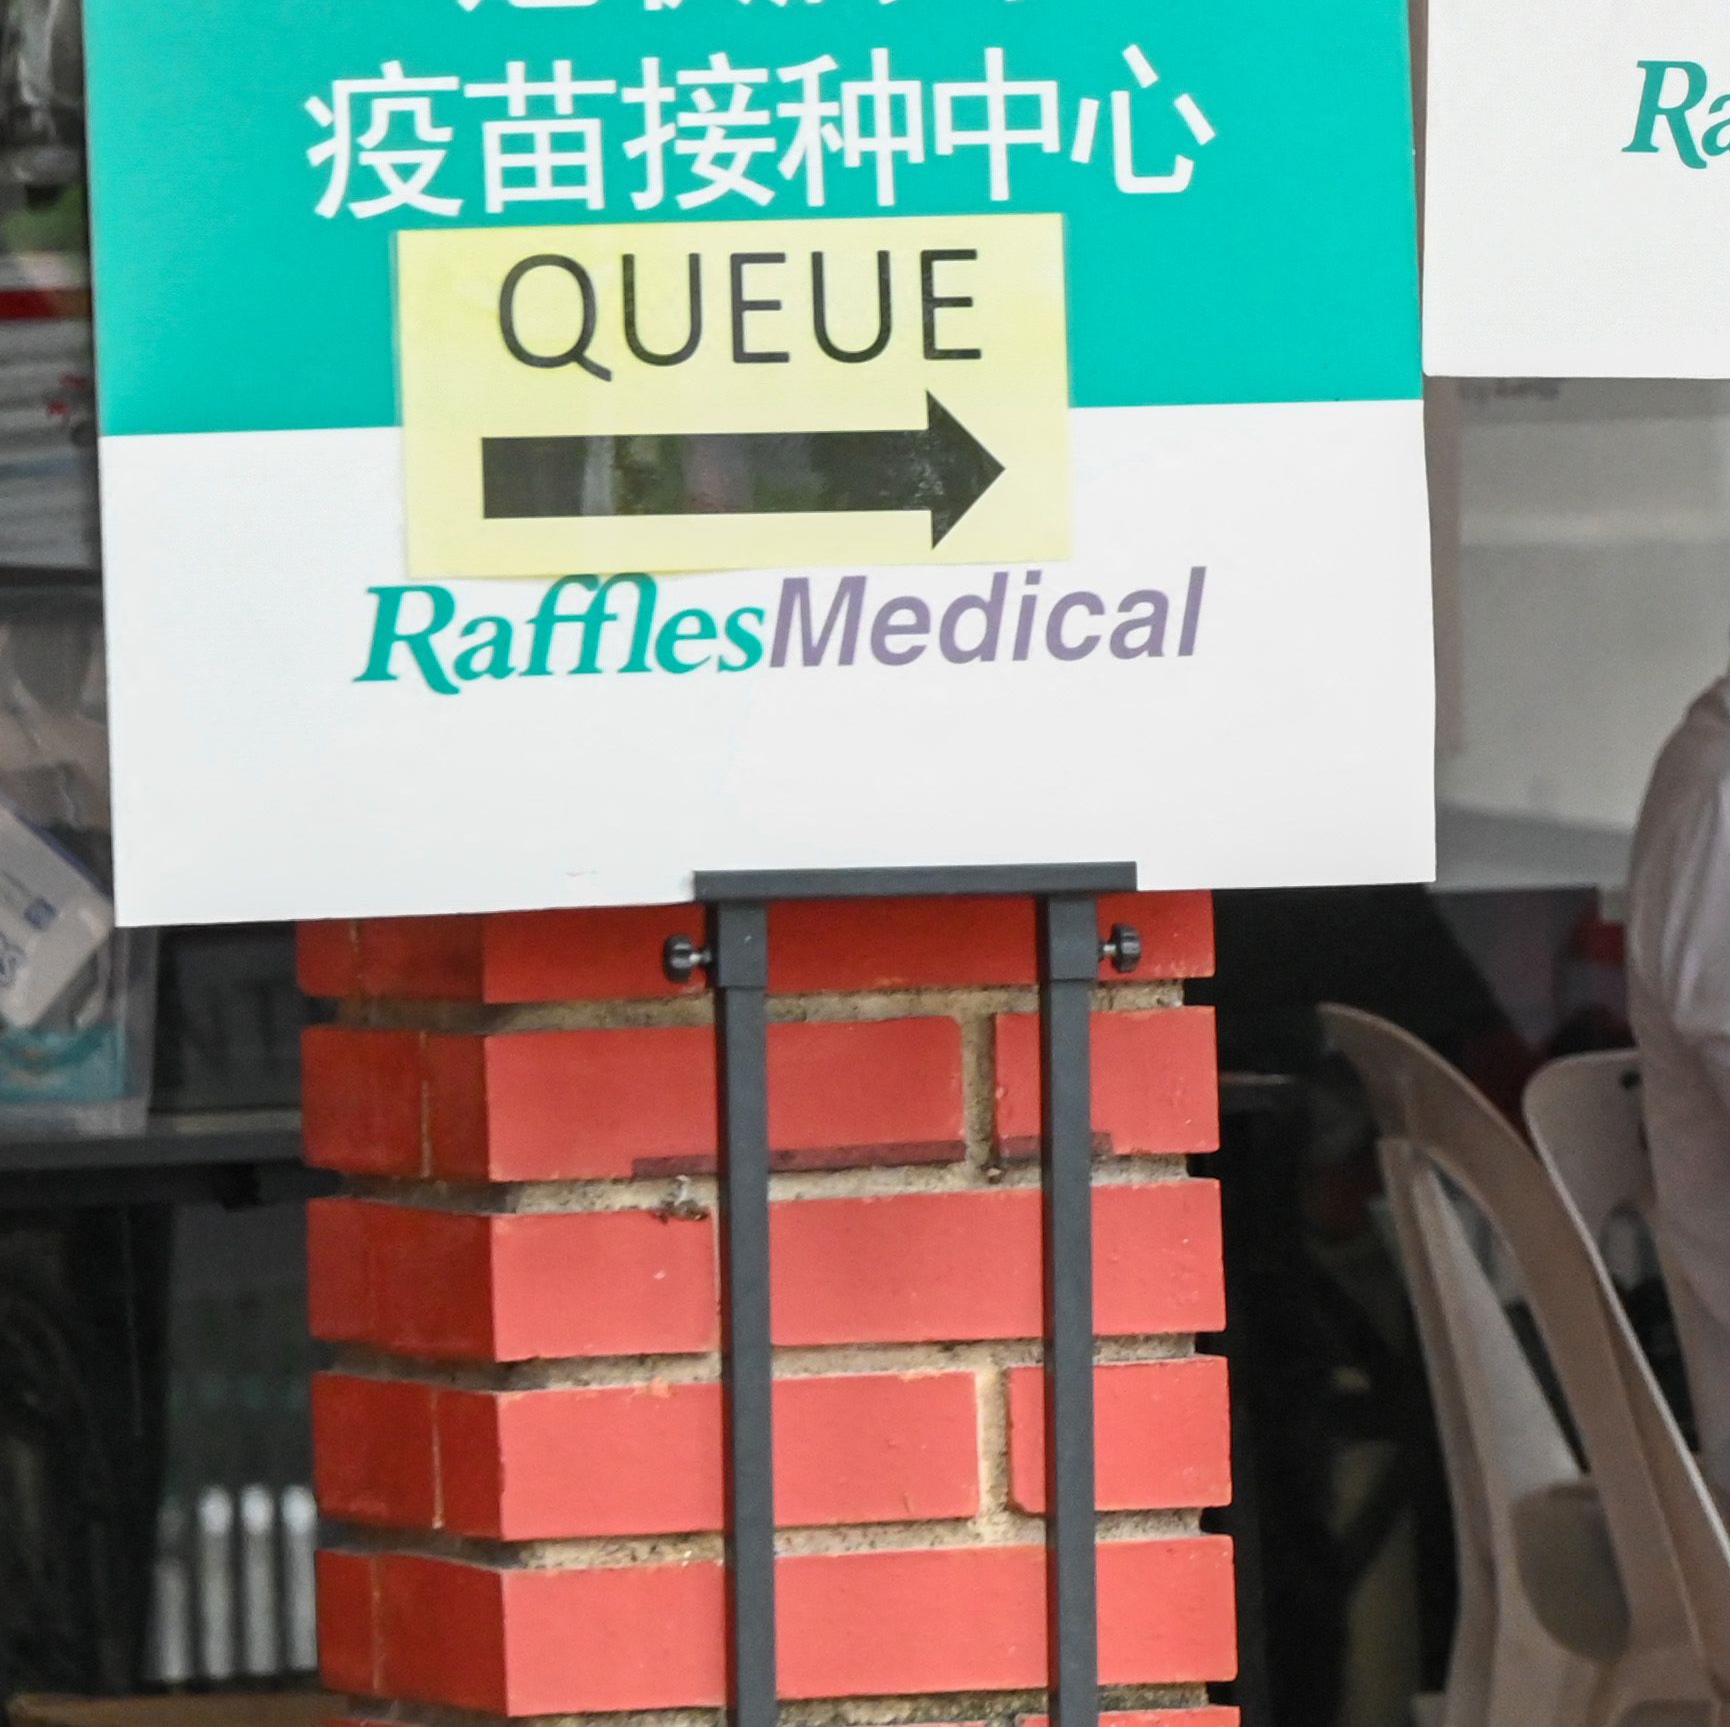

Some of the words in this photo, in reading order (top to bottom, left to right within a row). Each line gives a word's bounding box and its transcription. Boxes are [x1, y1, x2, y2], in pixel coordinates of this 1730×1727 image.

[306, 45, 1216, 219] 疫苗接种中心
[500, 250, 981, 381] QUEUE
